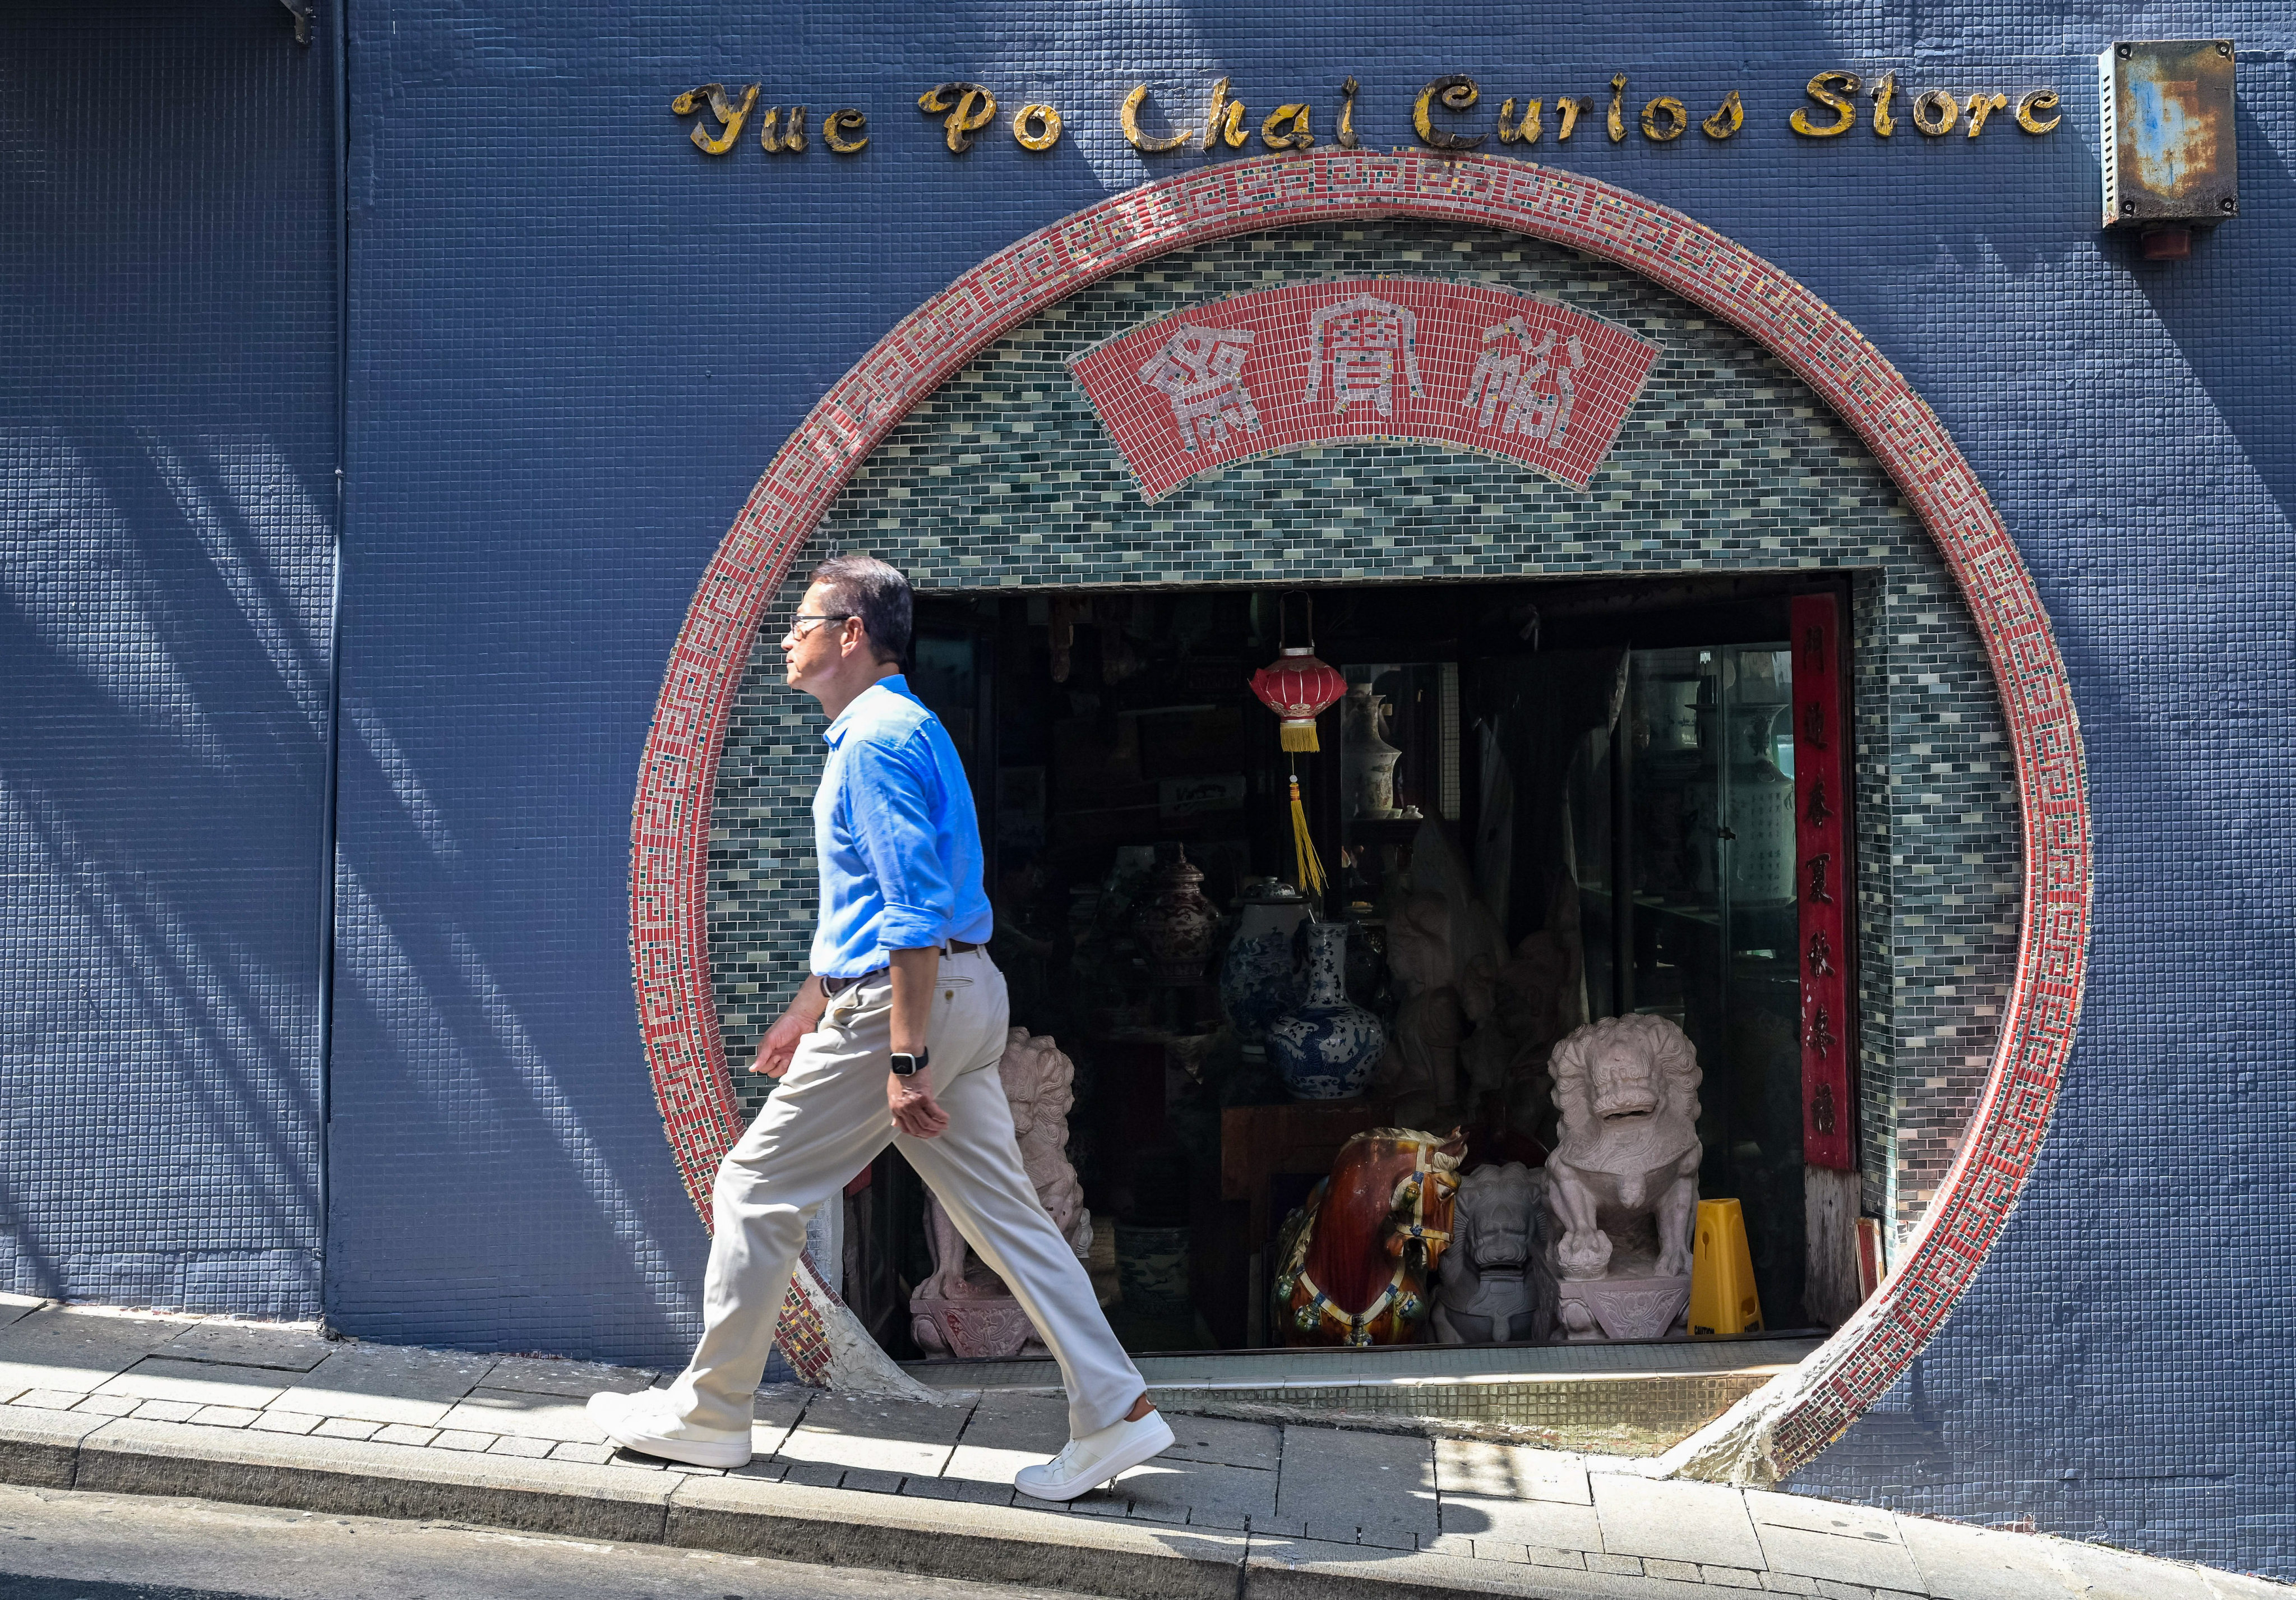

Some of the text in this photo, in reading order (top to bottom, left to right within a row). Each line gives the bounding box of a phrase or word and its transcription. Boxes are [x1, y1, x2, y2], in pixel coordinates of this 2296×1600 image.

[672, 68, 2062, 154] Yue Po Chai Curios Store
